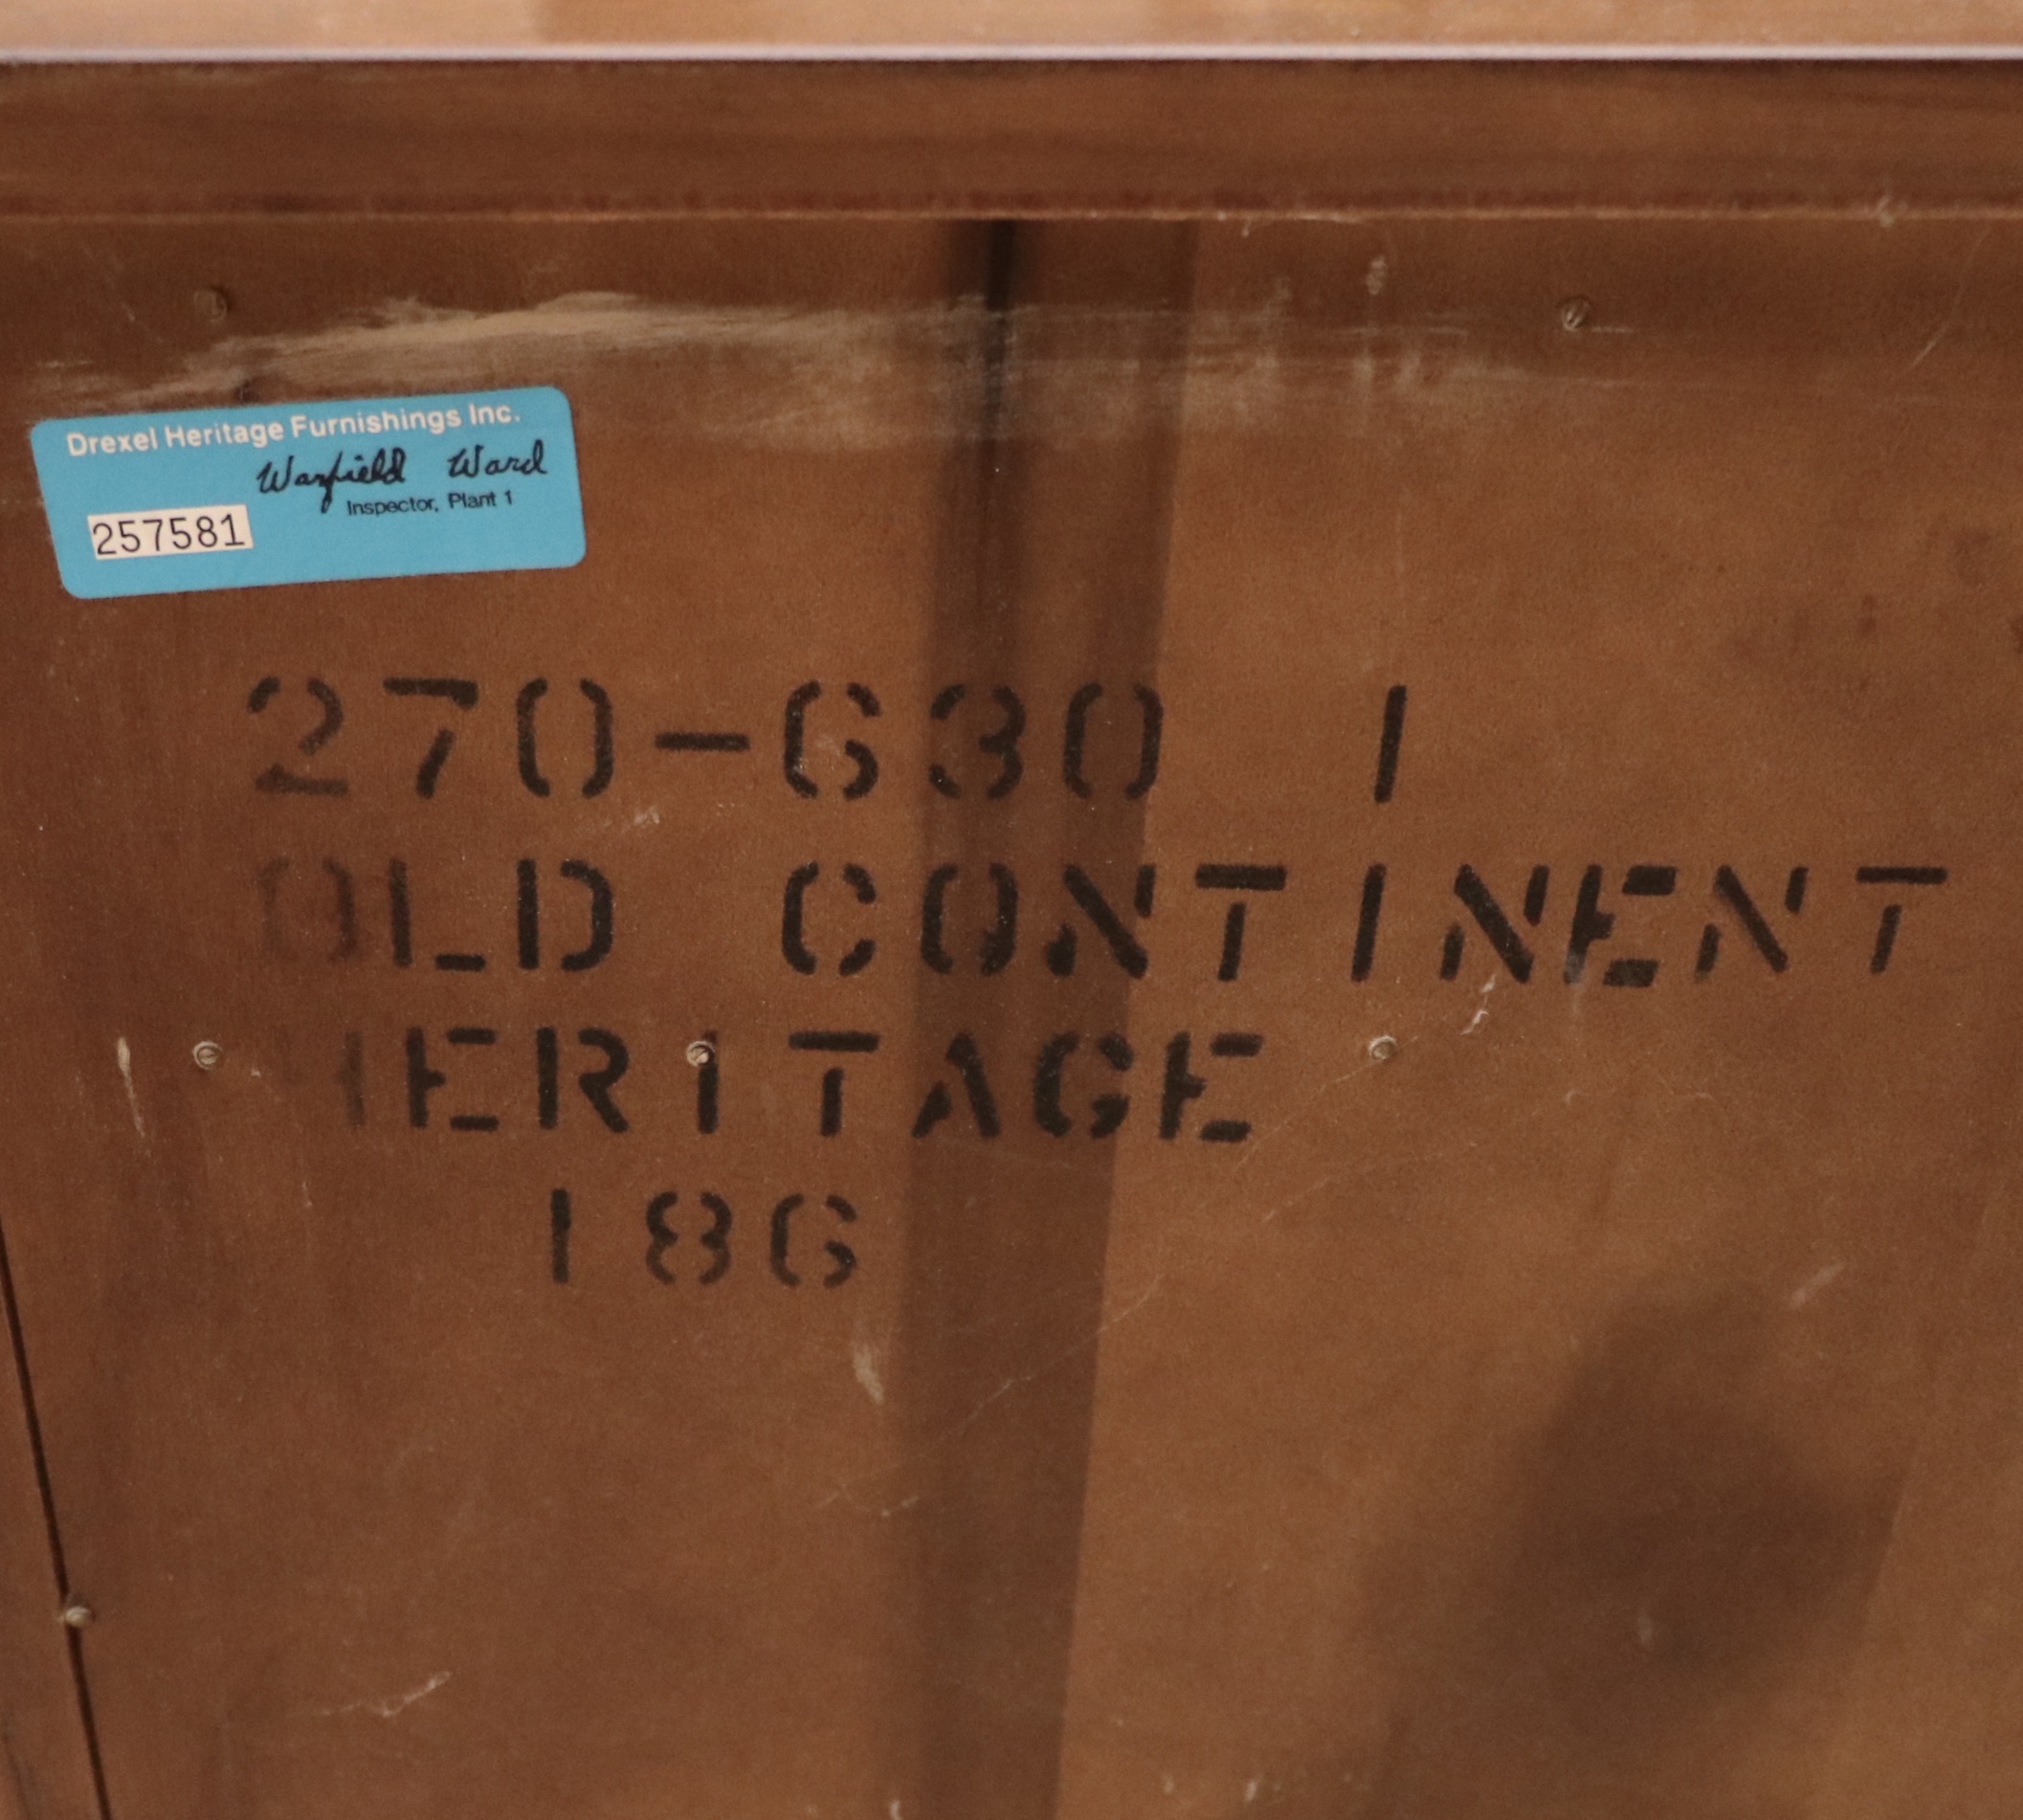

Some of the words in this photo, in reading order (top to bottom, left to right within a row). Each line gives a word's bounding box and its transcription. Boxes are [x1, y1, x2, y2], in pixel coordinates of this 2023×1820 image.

[66, 426, 158, 456] Drexel
[165, 417, 284, 449] Heritage
[291, 406, 461, 435] Furnishings
[468, 403, 521, 426] Inc.
[447, 438, 548, 478] Ward
[346, 493, 439, 519] Inspector,
[448, 490, 497, 509] Plant
[503, 489, 513, 505] 1
[91, 513, 246, 556] 257581
[247, 676, 1165, 800] 270-630
[256, 858, 614, 972] OLD
[780, 858, 1948, 988] CONTINENT
